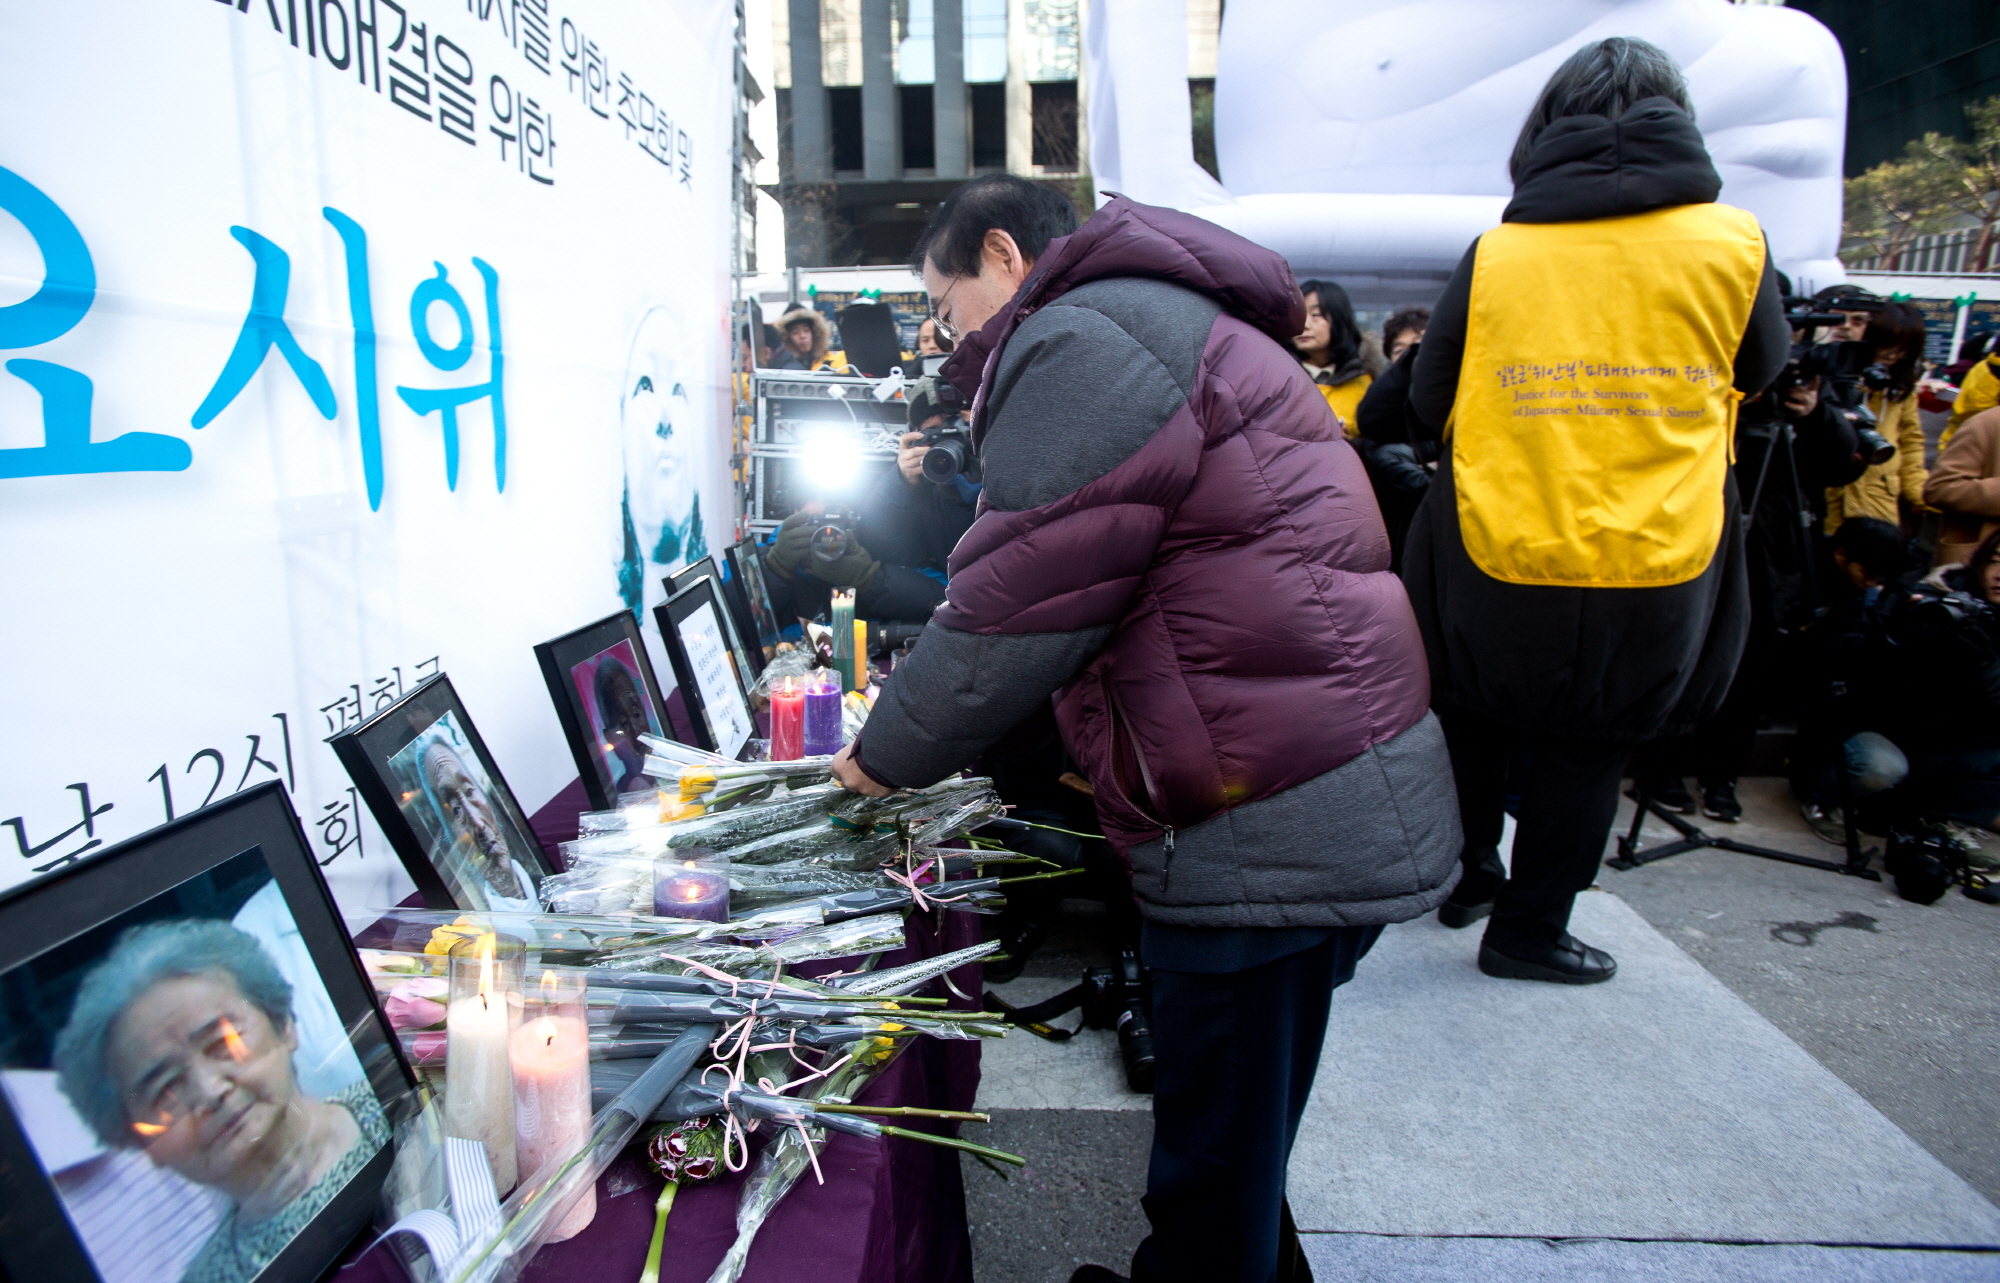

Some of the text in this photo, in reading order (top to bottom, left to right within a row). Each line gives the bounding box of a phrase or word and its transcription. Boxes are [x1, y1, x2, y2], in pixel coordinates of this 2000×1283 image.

[488, 74, 556, 187] 위한
[560, 17, 609, 120] 위한
[615, 71, 673, 176] 추모회
[676, 128, 693, 193] 및
[1513, 387, 1649, 403] Justice for the Survivors
[1513, 405, 1523, 417] of
[1522, 405, 1573, 419] Japanese
[1575, 404, 1622, 418] Military
[1625, 404, 1663, 417] Sexual
[148, 712, 297, 821] 12시
